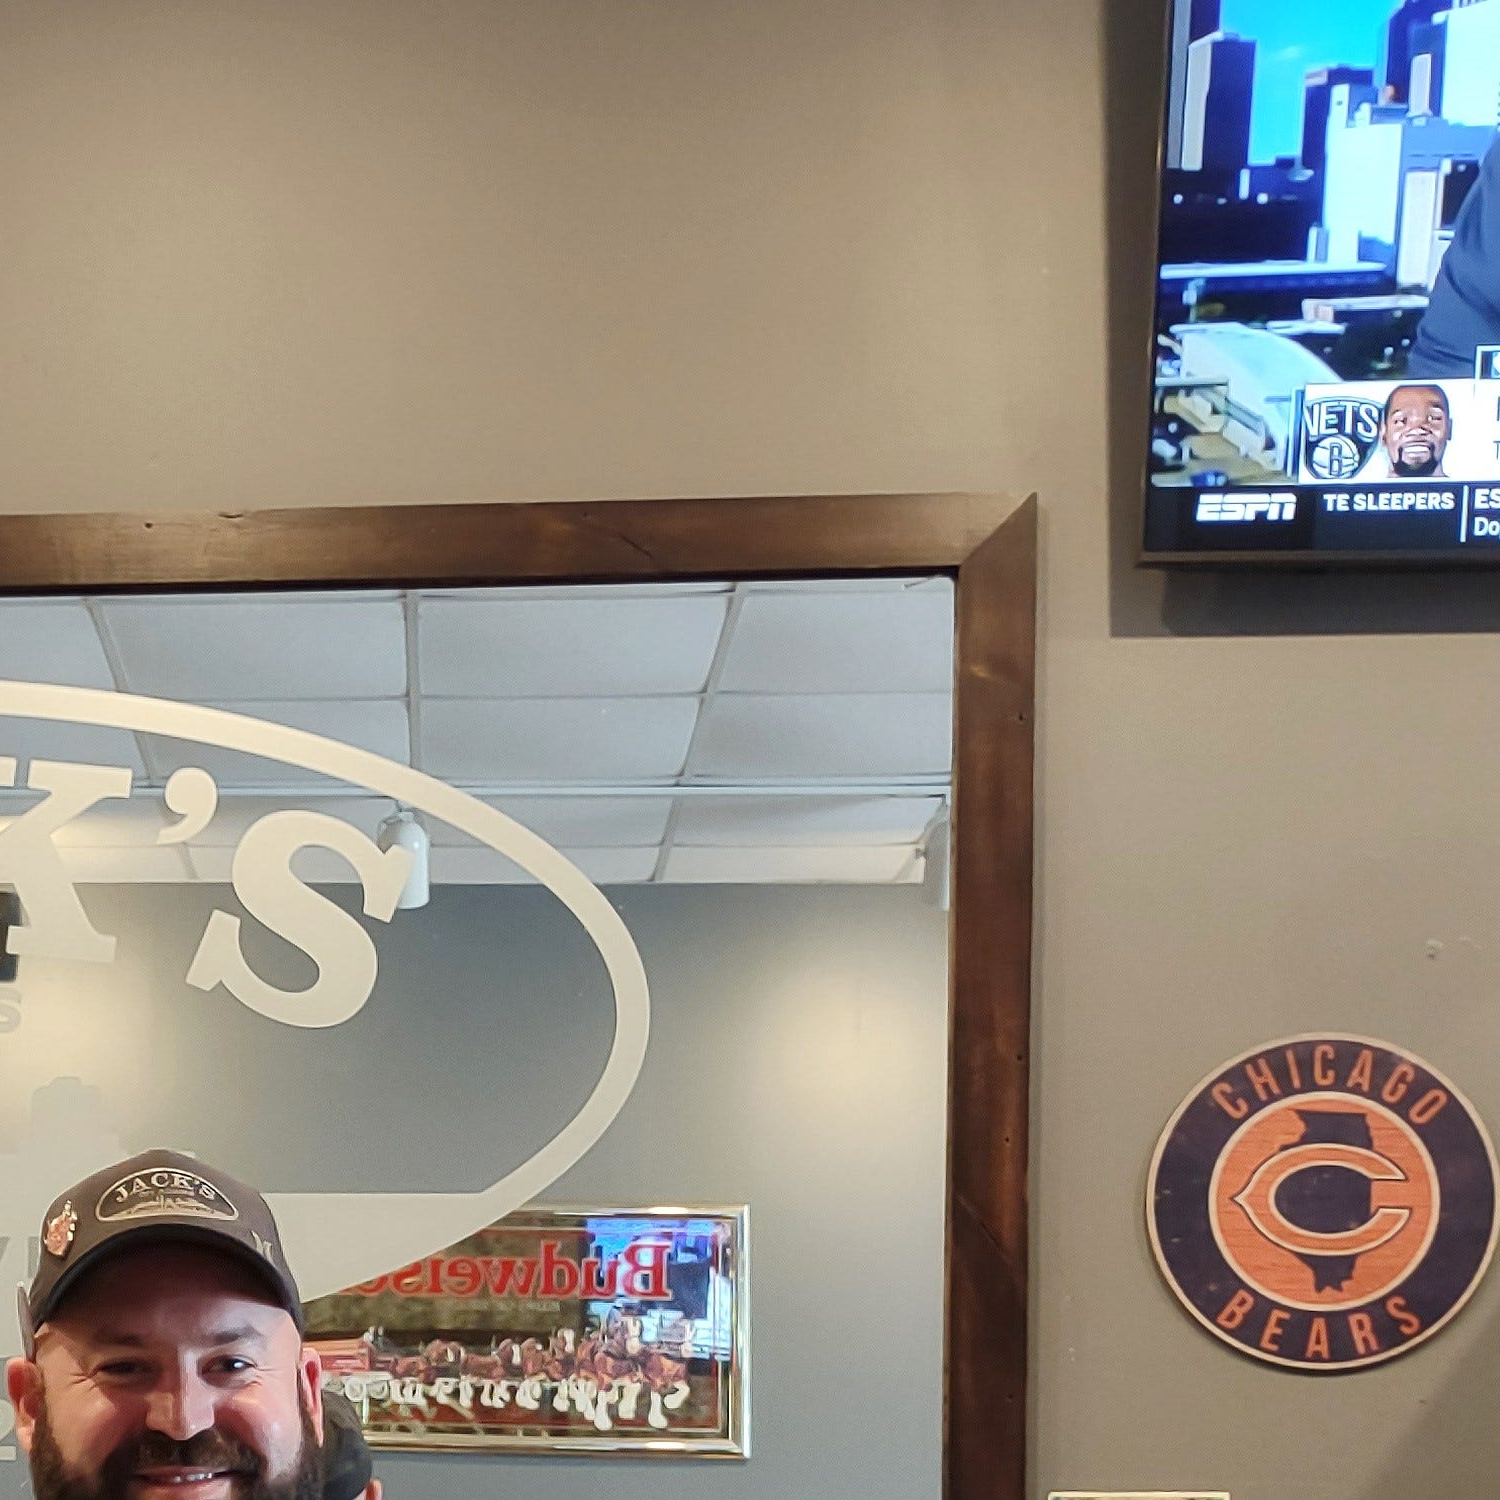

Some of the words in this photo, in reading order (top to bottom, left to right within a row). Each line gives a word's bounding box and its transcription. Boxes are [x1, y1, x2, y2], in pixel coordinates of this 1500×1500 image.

[1196, 493, 1297, 522] ESPN
[1323, 493, 1349, 511] TE
[1353, 492, 1455, 511] SLEEPERS
[1211, 1044, 1447, 1124] CHICAGO
[116, 1173, 216, 1202] JACK'S
[1216, 1289, 1422, 1360] BEARS
